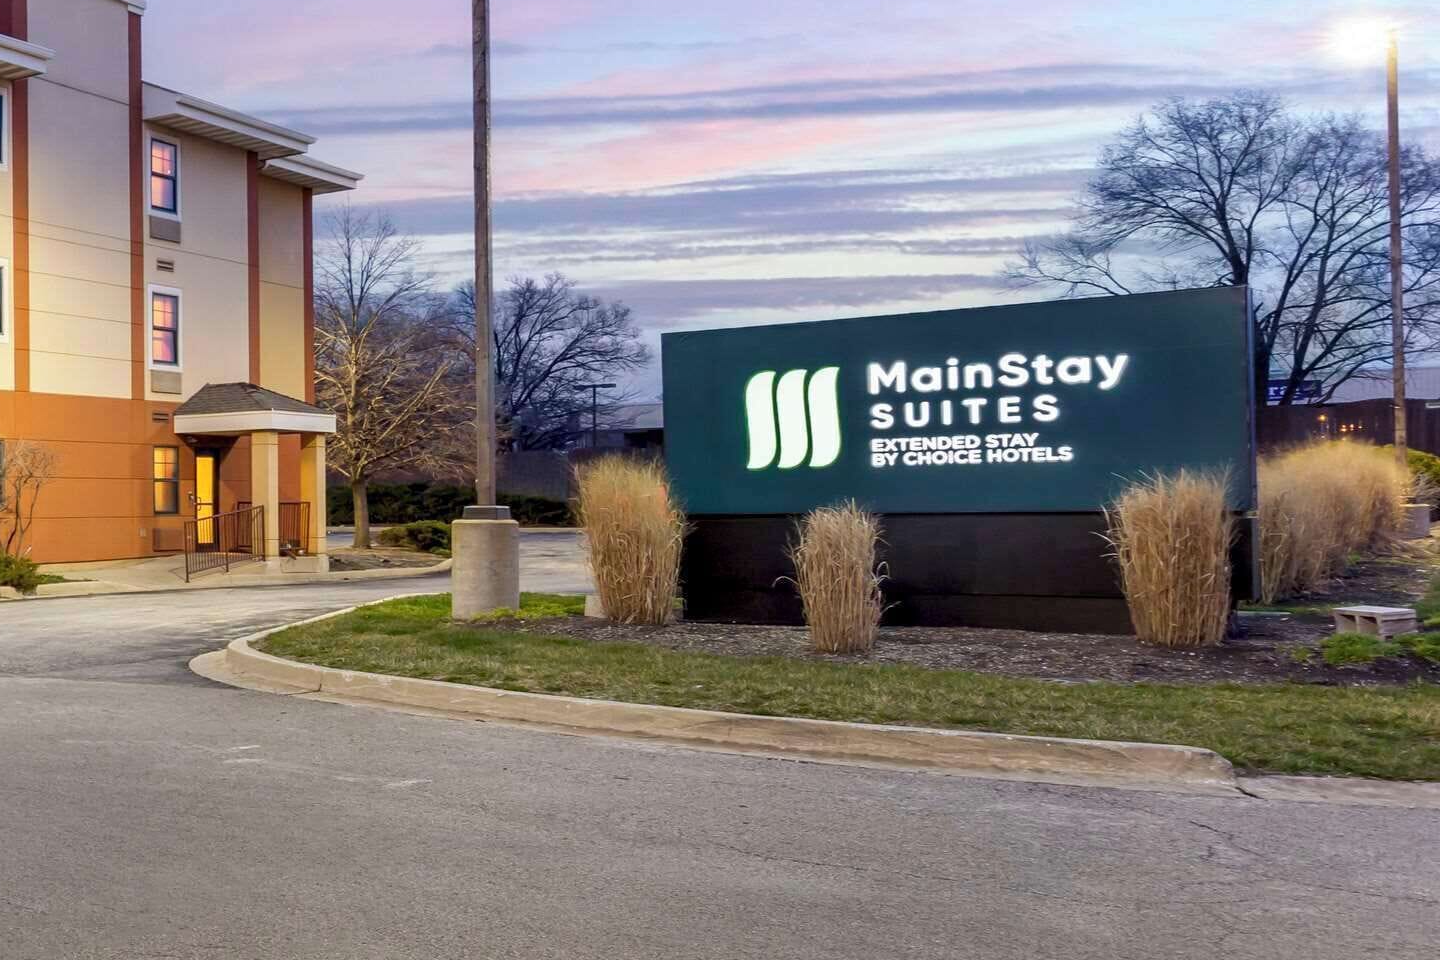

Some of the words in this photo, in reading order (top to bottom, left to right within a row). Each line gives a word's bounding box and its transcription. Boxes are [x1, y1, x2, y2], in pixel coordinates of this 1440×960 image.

[866, 352, 1129, 395] MainStay
[869, 393, 1060, 429] SUITES
[870, 435, 981, 453] EXTENDED
[985, 432, 1040, 448] STAY
[870, 452, 899, 468] BY
[903, 449, 982, 466] CHOICE
[986, 445, 1074, 463] HOTELS
